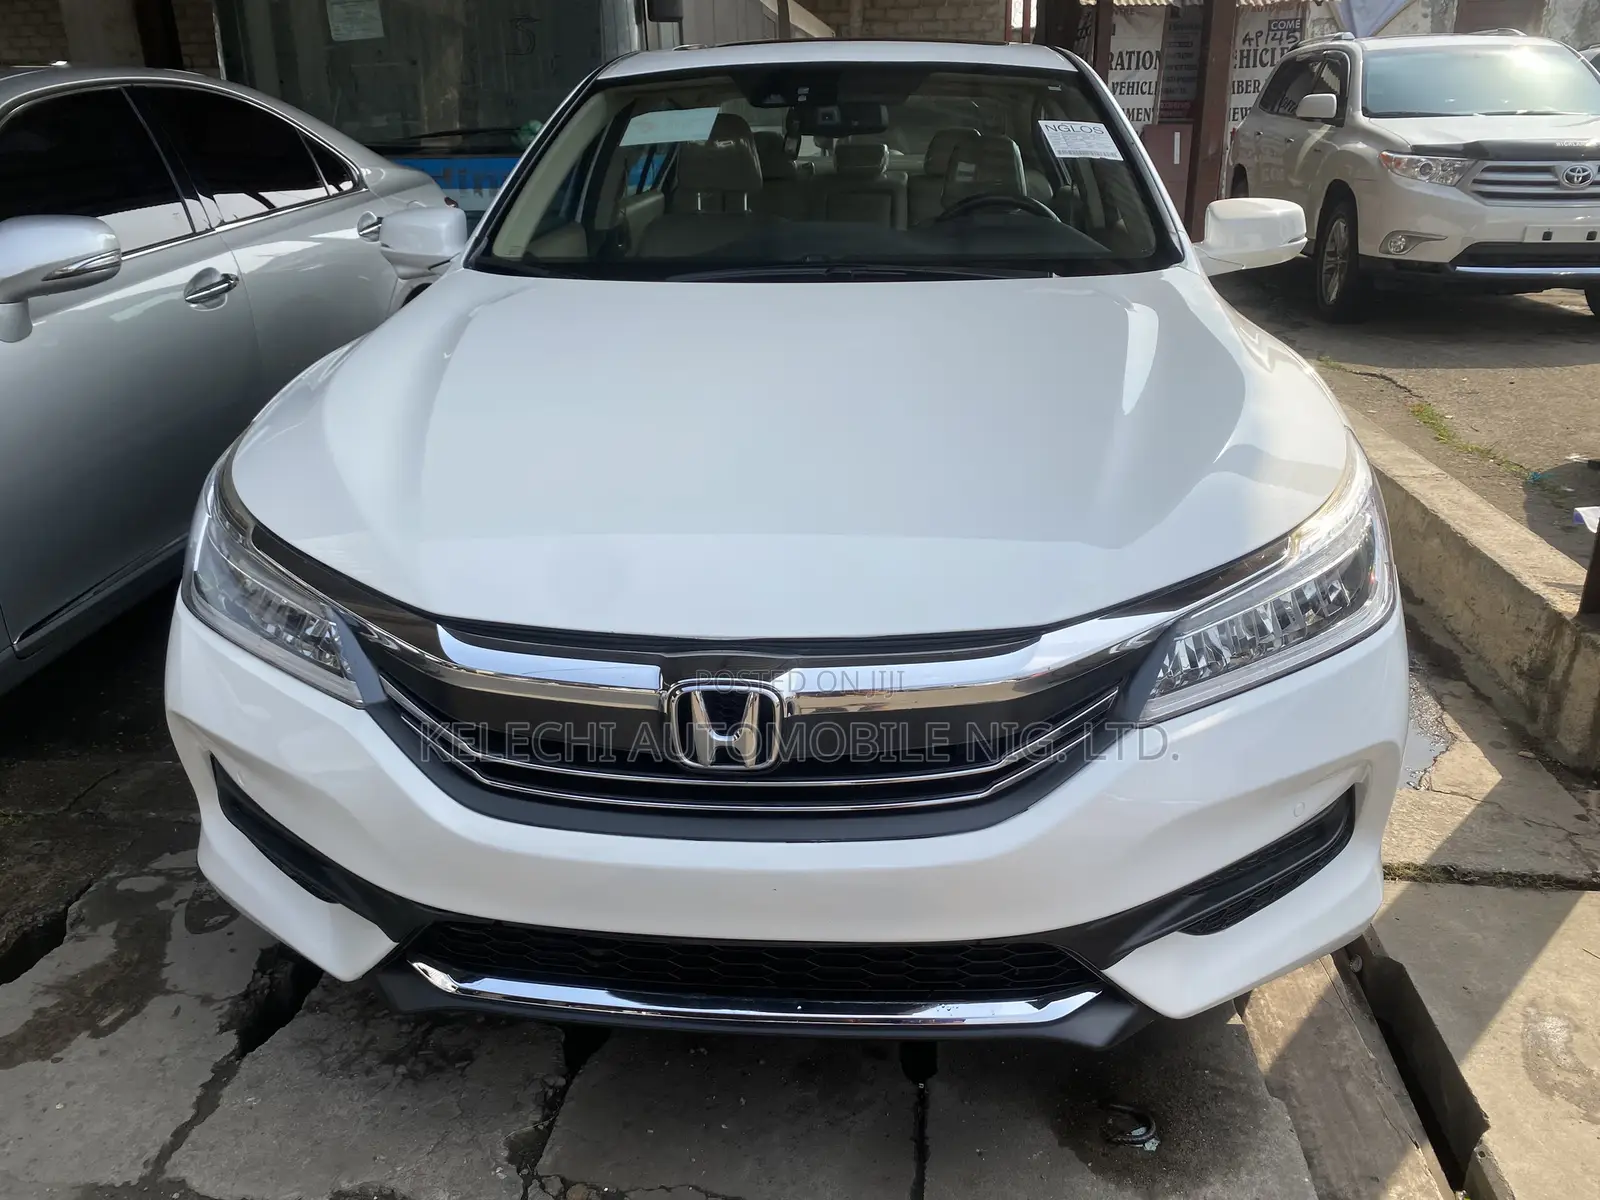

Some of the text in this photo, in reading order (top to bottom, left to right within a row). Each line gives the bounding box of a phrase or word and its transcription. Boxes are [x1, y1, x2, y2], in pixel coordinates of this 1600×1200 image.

[1270, 20, 1301, 31] COME
[1233, 46, 1289, 69] HICL
[1231, 79, 1261, 95] BER
[1122, 107, 1154, 122] MEN
[1044, 123, 1105, 135] NGLOS
